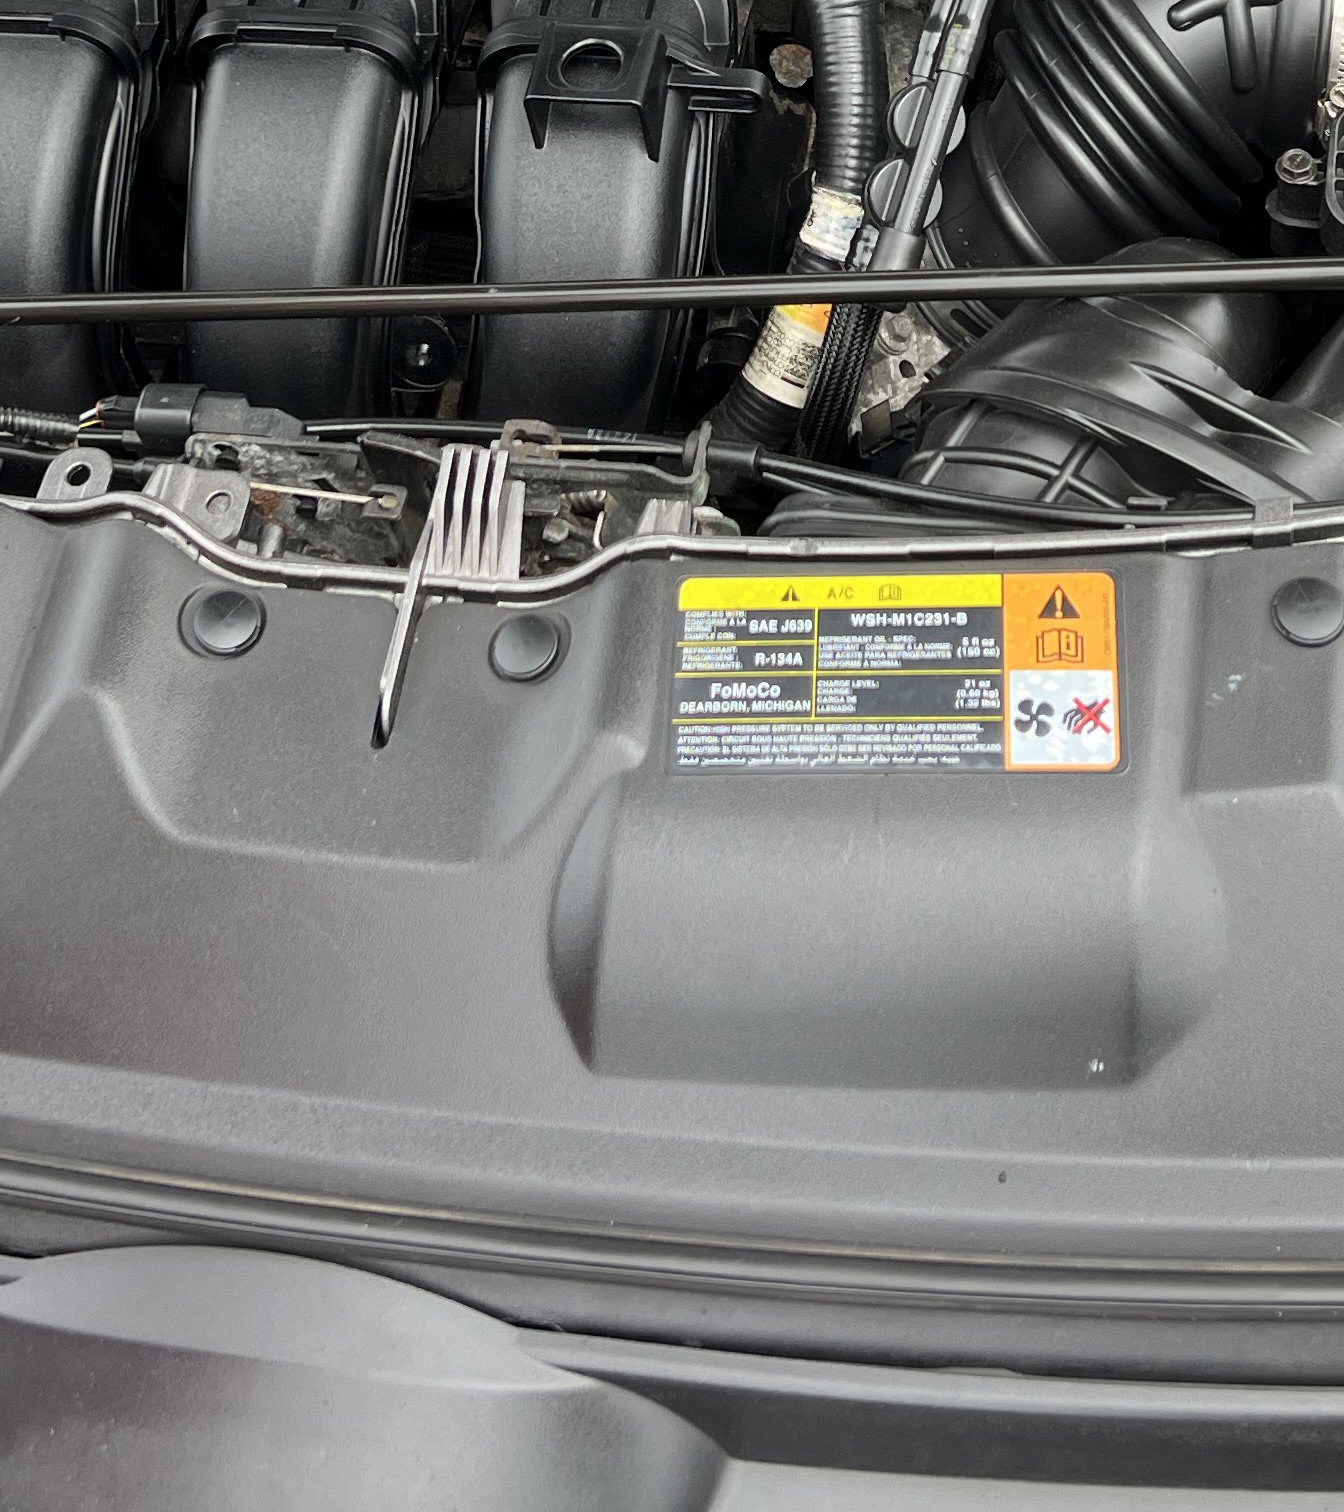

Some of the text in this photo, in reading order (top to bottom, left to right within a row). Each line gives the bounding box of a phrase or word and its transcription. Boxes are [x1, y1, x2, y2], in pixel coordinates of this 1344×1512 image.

[827, 587, 854, 600] A/C
[850, 612, 968, 627] WSH-M1C231-B
[749, 618, 813, 634] SAE J639
[982, 638, 995, 646] oz
[864, 651, 886, 660] PARA
[957, 646, 980, 659] (150
[754, 652, 803, 667] R-134A
[817, 680, 850, 688] CHARGE
[964, 679, 992, 688] 21 oz
[710, 682, 781, 699] FoMoCo
[816, 696, 845, 704] CARGA
[680, 700, 811, 714] DEARBORN, MICHIGAN
[732, 725, 771, 734] PRESSURE
[772, 724, 802, 733] SYSTEM
[803, 724, 814, 733] TO
[826, 724, 863, 732] SERVICED
[864, 724, 884, 732] ONLY
[885, 724, 896, 732] BY
[896, 724, 936, 733] QUALIFIED
[751, 735, 772, 744] SOUS
[773, 735, 798, 743] HAUTE
[923, 744, 960, 753] PERSONAL
